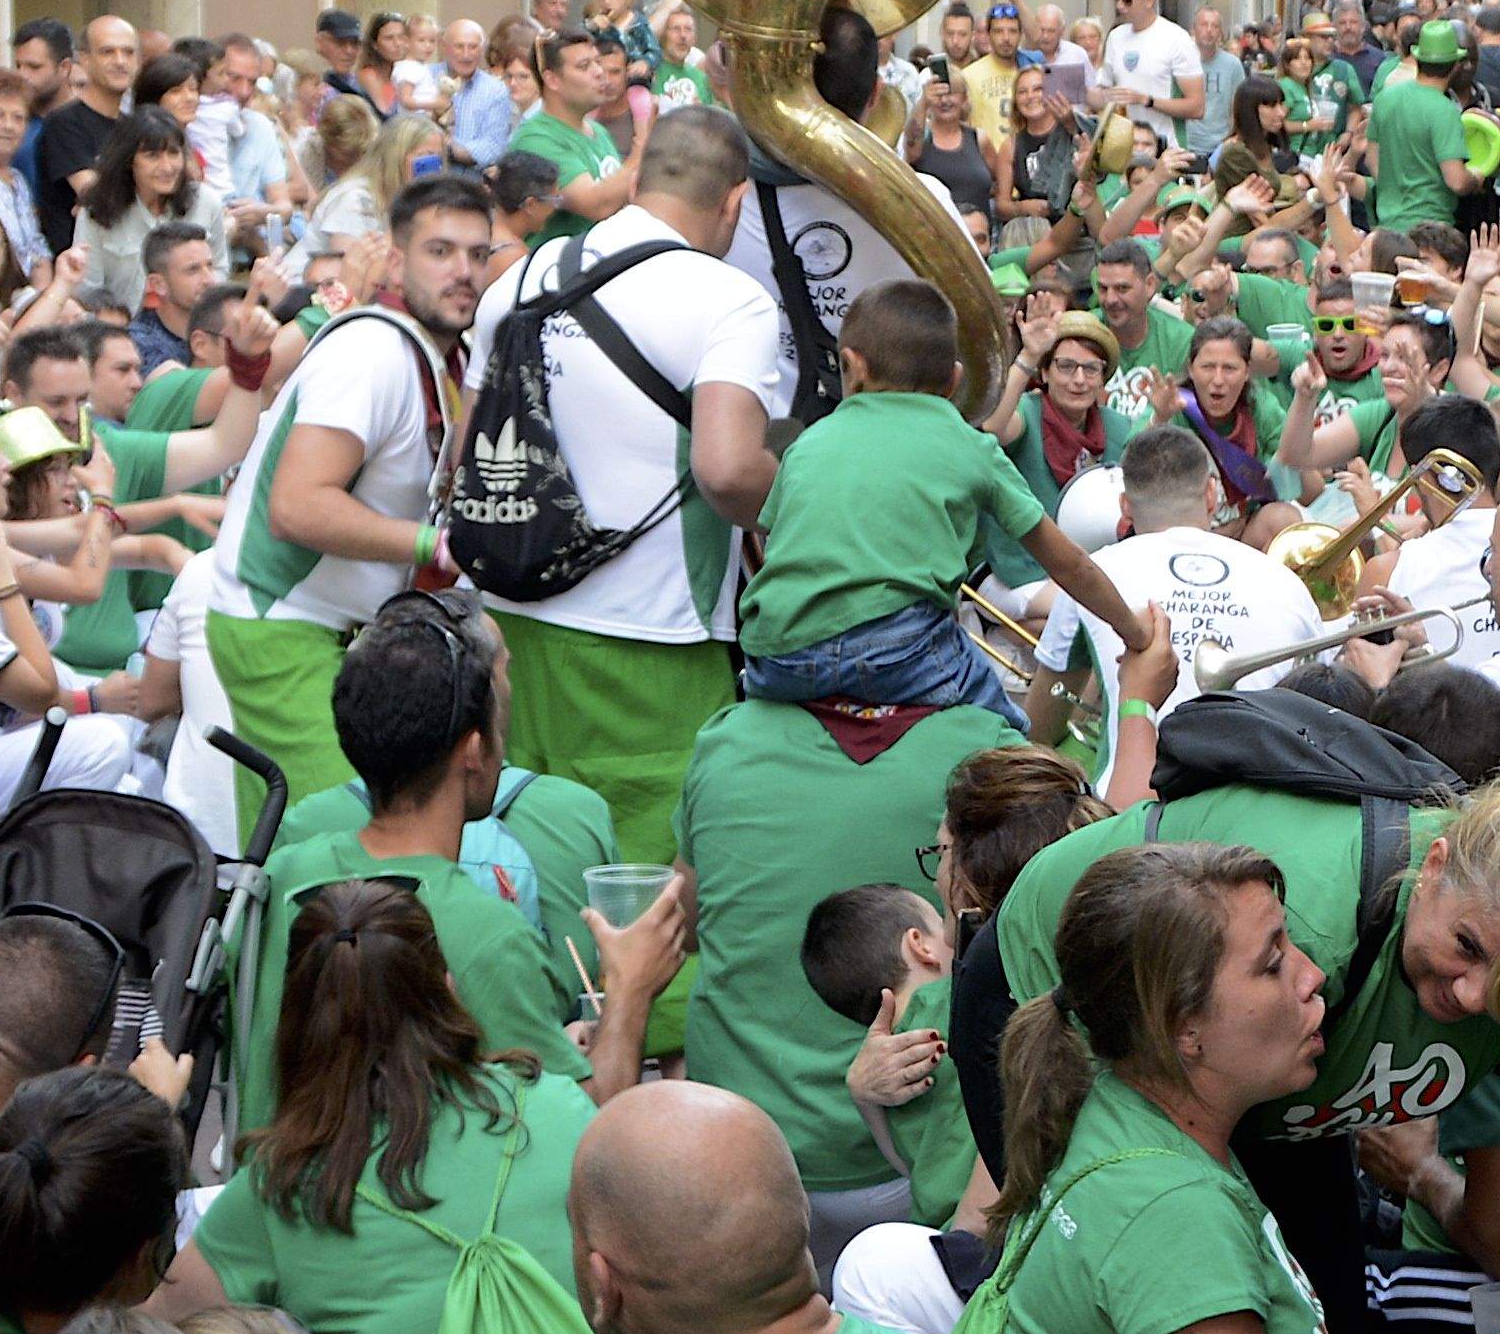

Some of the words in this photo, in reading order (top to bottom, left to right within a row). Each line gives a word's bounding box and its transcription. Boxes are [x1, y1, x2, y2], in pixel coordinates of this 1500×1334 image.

[463, 494, 539, 523] adidas
[1172, 589, 1232, 602] MEJOR
[1157, 600, 1250, 618] HARANGA
[1192, 616, 1216, 631] DE
[1330, 1041, 1467, 1118] 40
